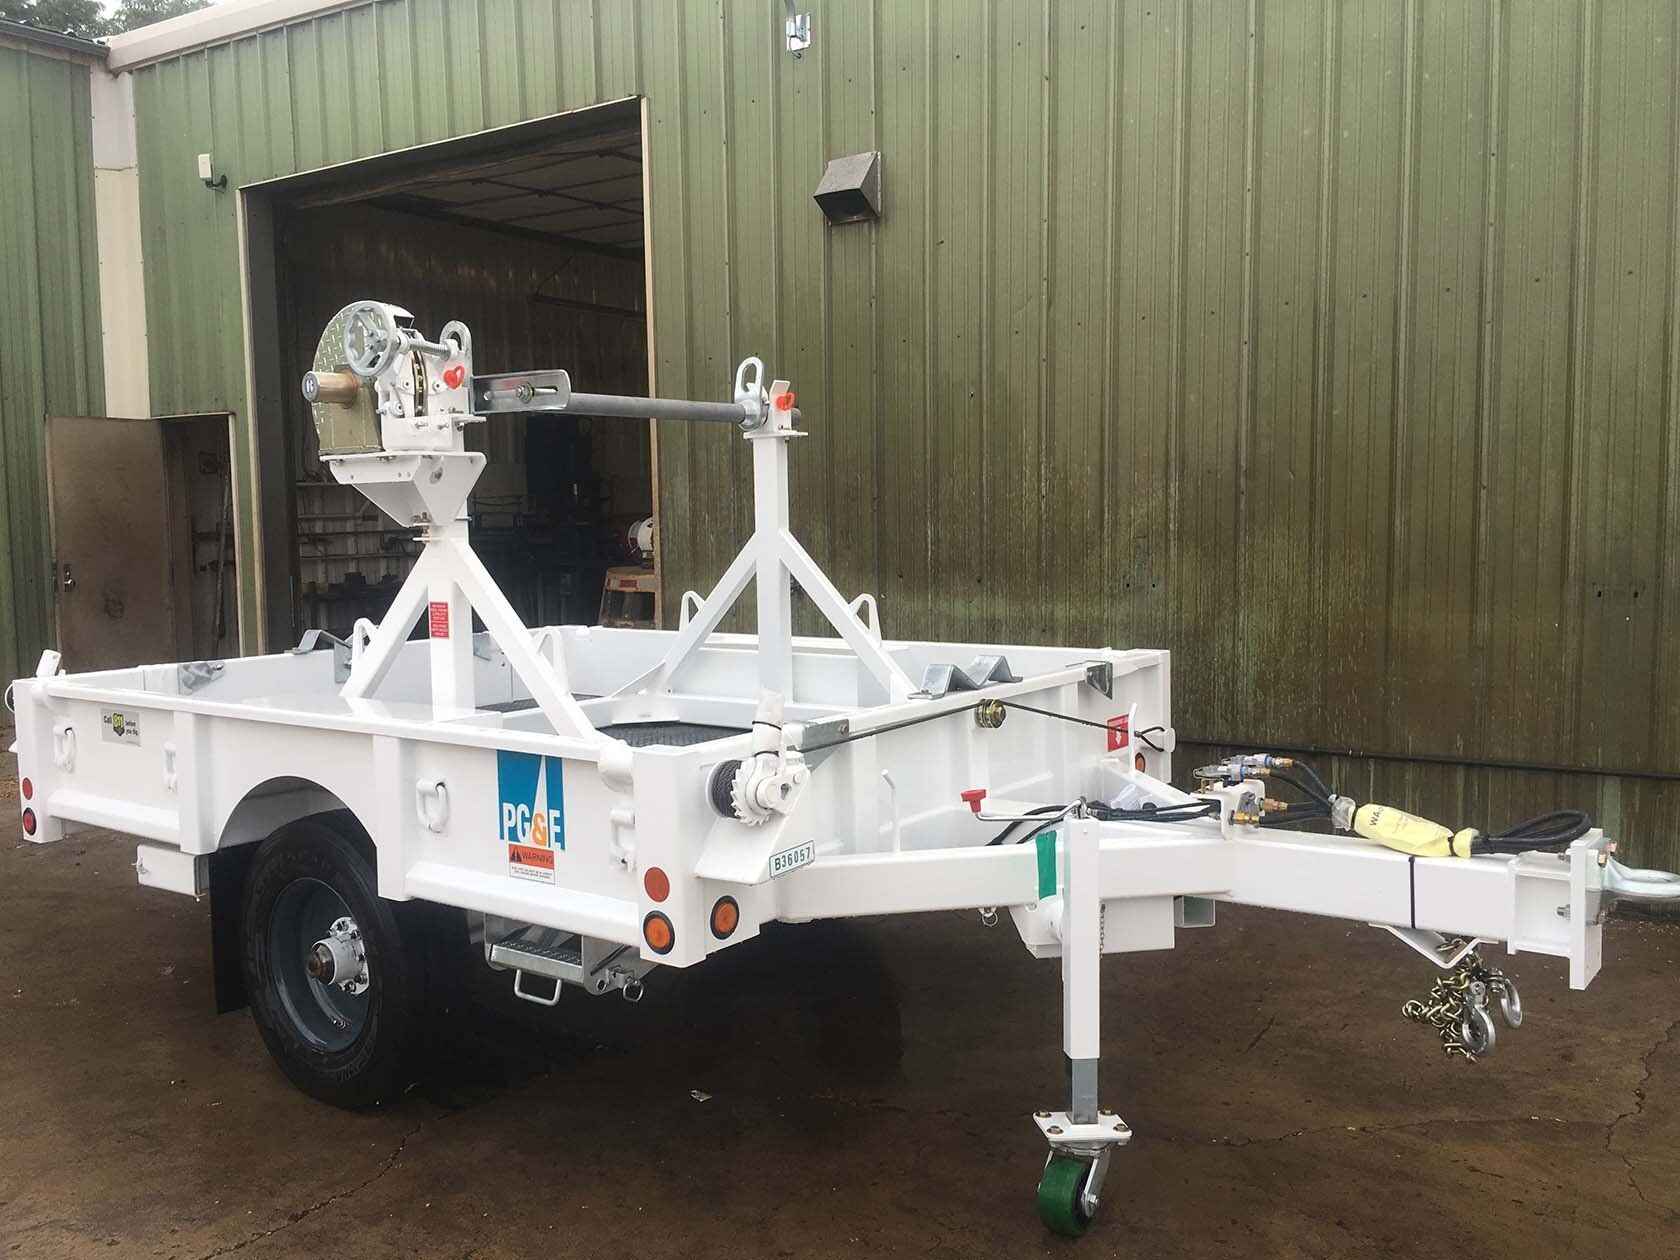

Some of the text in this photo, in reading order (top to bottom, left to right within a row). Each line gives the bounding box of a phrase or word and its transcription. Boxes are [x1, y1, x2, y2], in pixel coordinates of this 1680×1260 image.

[502, 802, 562, 850] PG&E
[521, 850, 554, 865] WARNING
[774, 846, 811, 871] B36057
